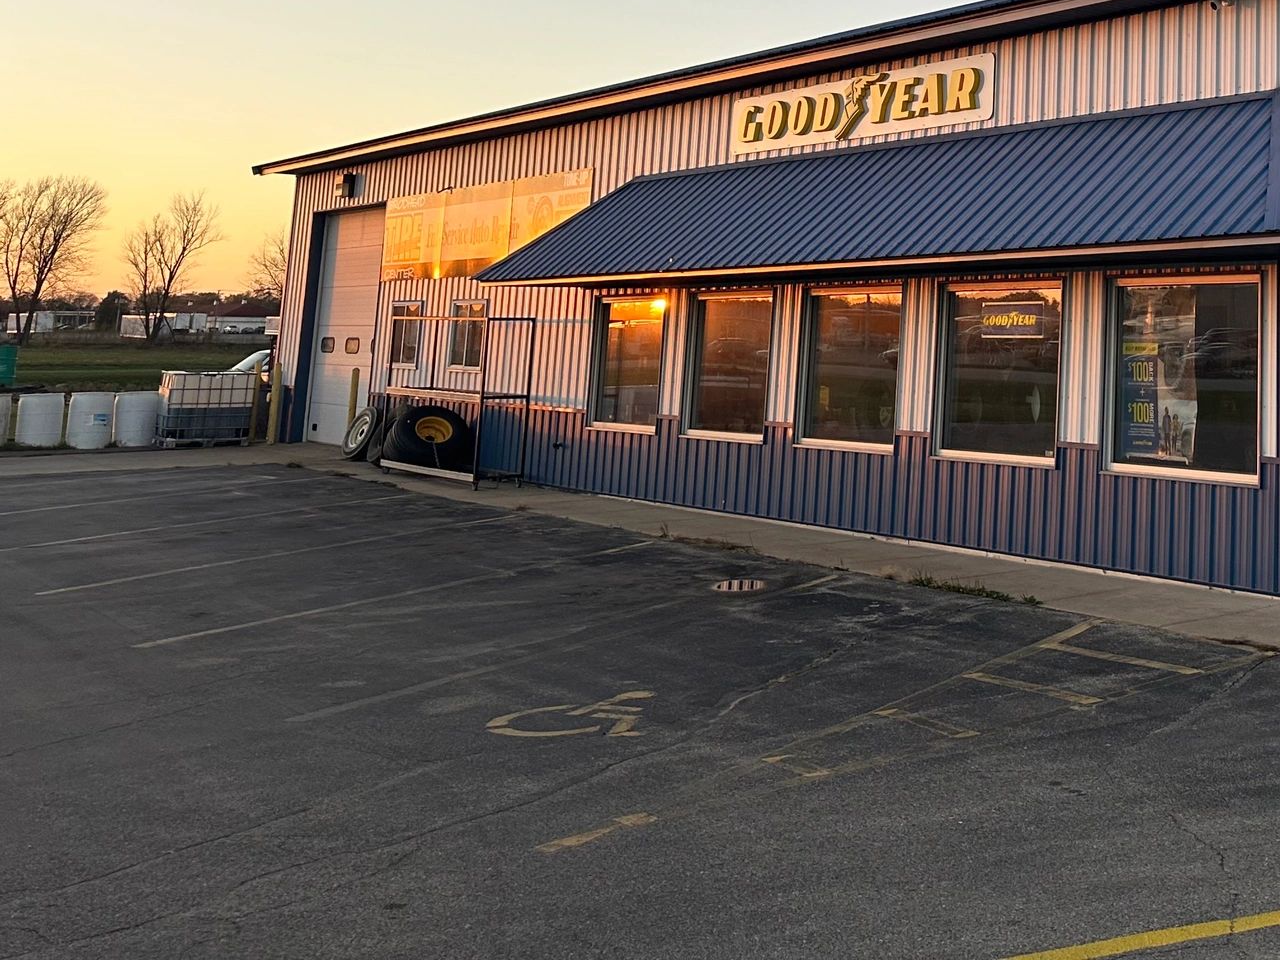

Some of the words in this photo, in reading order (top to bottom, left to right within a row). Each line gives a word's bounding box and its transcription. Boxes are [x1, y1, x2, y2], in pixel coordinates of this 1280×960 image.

[739, 68, 983, 143] GOODYEAR
[385, 213, 424, 263] TIRE
[383, 267, 415, 280] CENTER
[983, 311, 1036, 328] GOODYEAR
[1128, 361, 1148, 382] $100
[1128, 402, 1149, 423] $100
